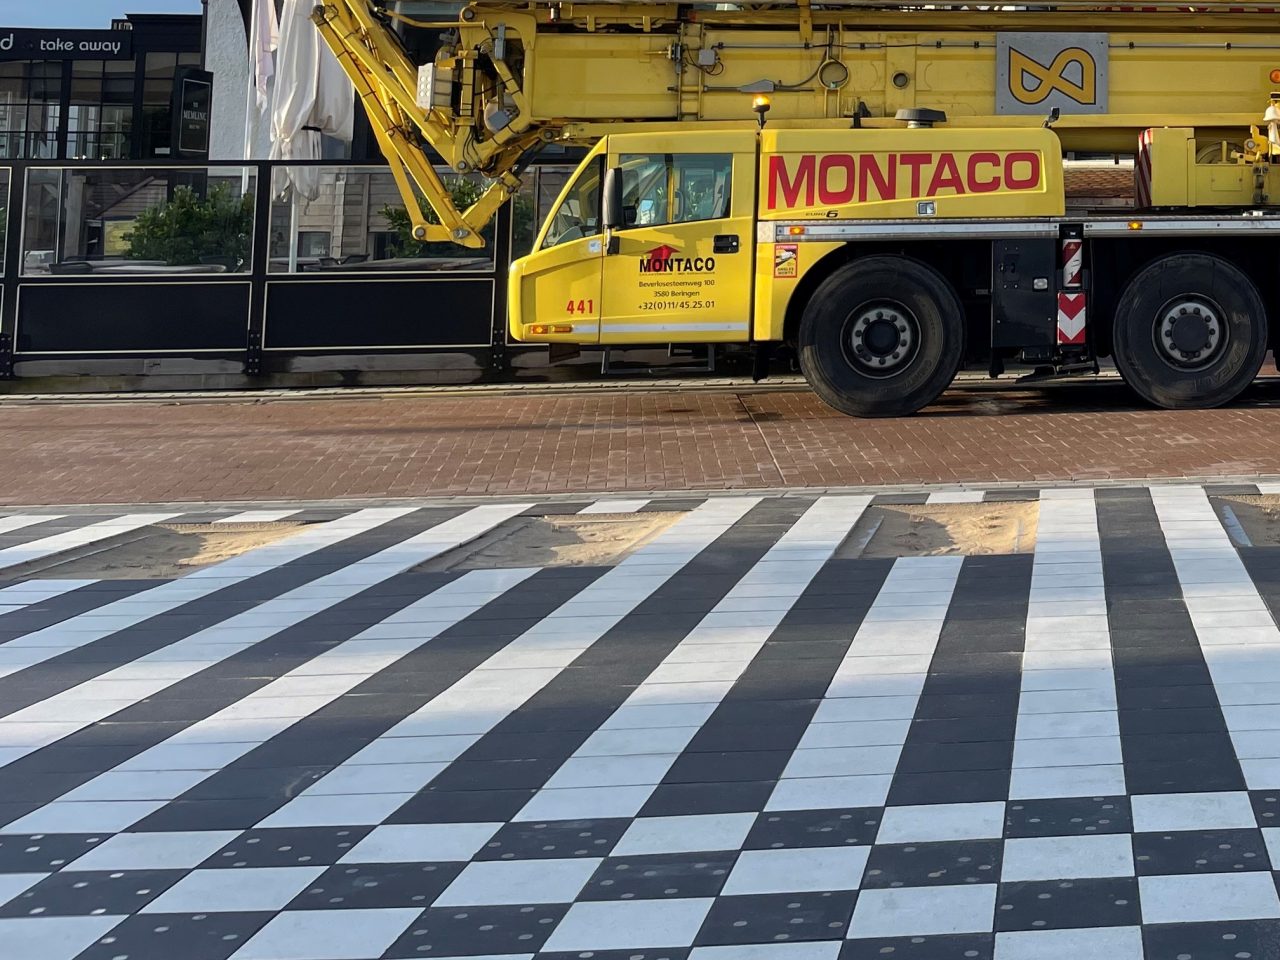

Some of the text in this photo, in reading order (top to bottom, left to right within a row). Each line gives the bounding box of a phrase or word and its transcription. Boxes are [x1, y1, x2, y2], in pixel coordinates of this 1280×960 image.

[40, 38, 74, 51] take
[79, 41, 121, 54] away
[767, 152, 1040, 210] MONTACO
[639, 257, 716, 273] MONTACO
[671, 290, 700, 299] Beringen
[566, 299, 594, 315] 441
